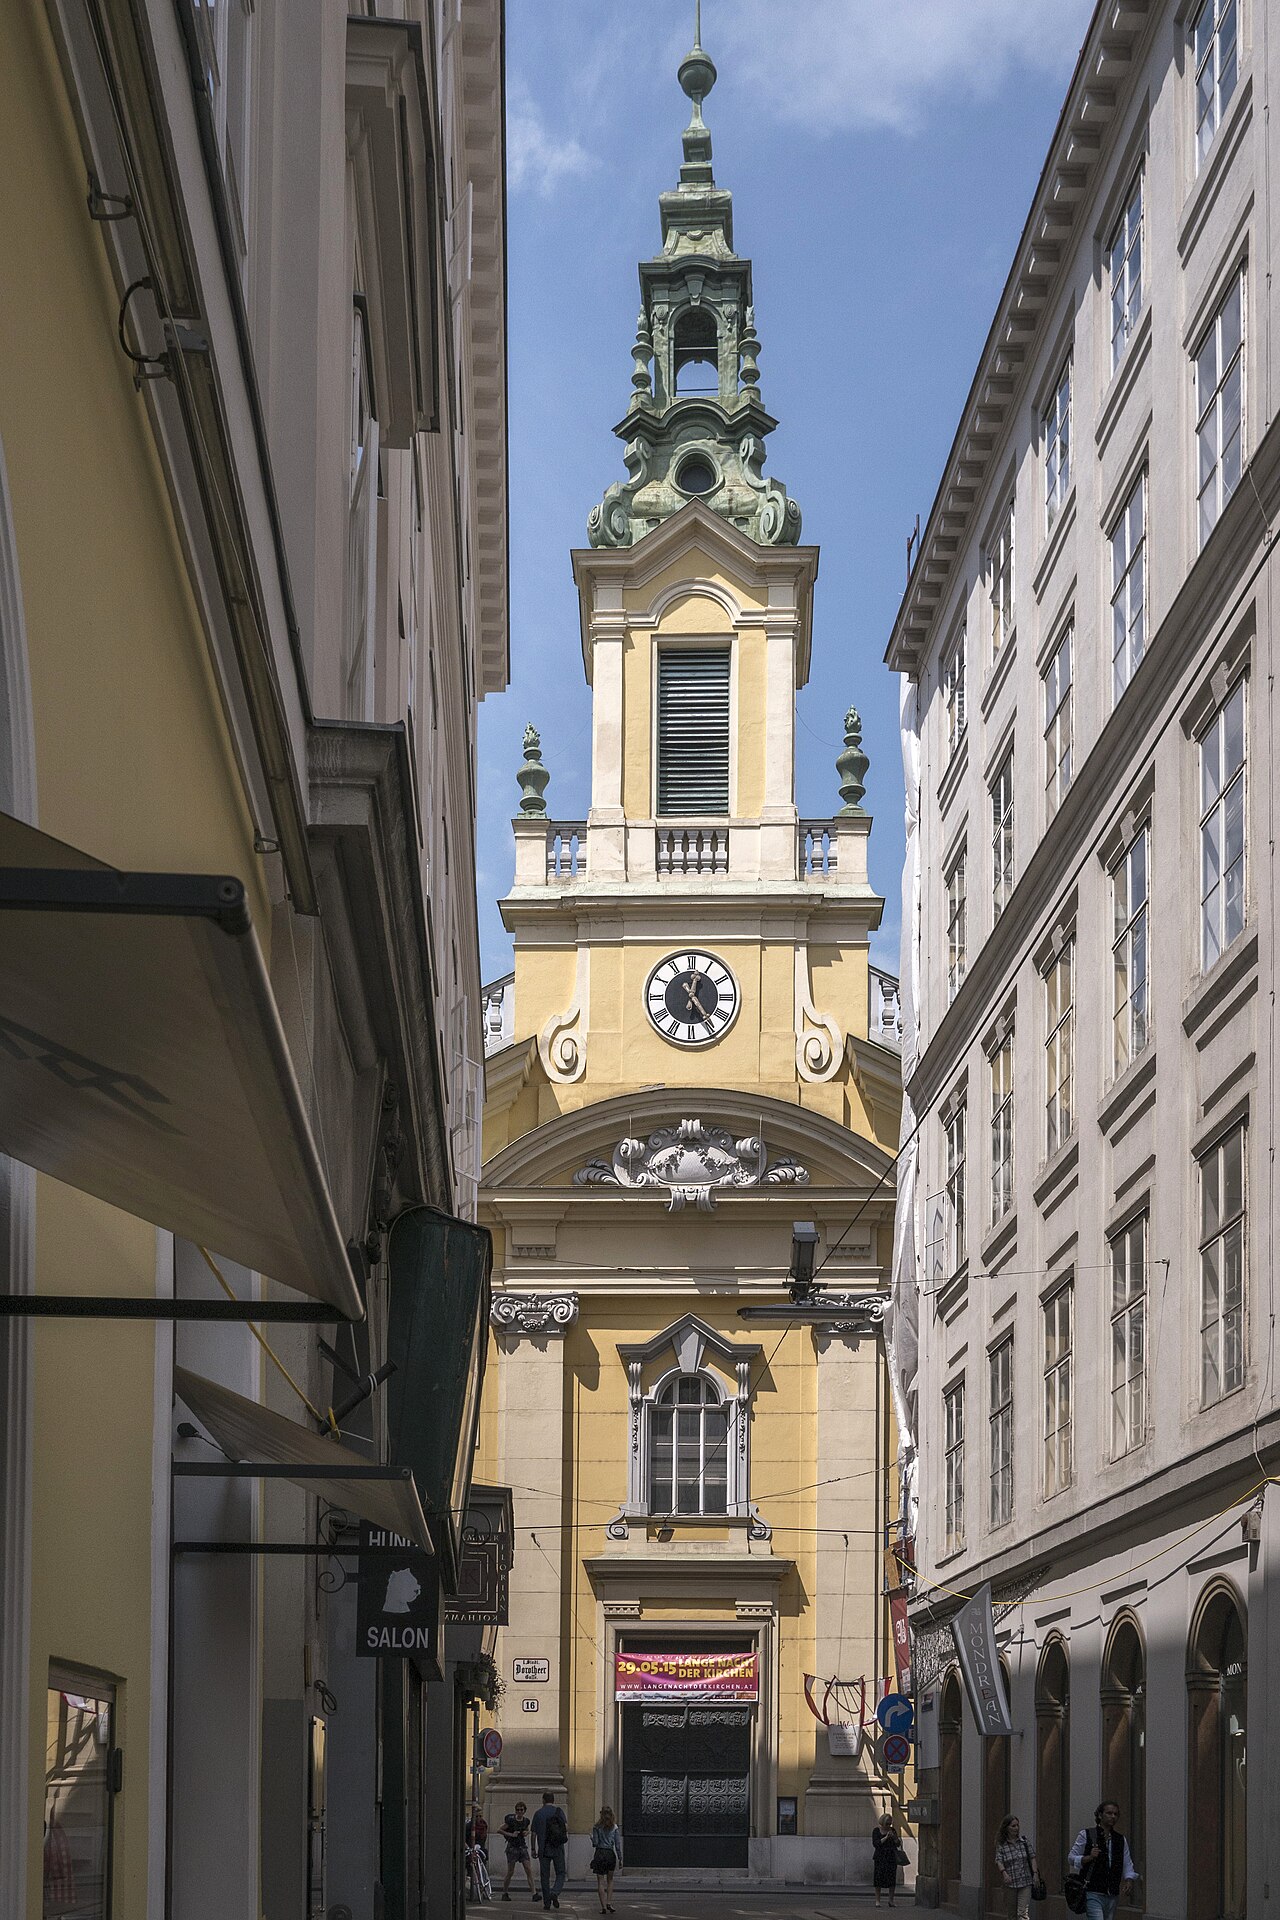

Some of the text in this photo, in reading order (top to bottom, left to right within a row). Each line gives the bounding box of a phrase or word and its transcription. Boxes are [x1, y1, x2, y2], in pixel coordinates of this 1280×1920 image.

[369, 1531, 419, 1547] HUN
[367, 1627, 428, 1649] SALON
[516, 1664, 547, 1675] Dorotheer
[618, 1657, 755, 1675] 29.05.15 LANGE NACHT
[679, 1668, 754, 1678] DER KIRCHEN
[970, 1623, 1001, 1726] MONDREAN
[525, 1701, 536, 1710] 16
